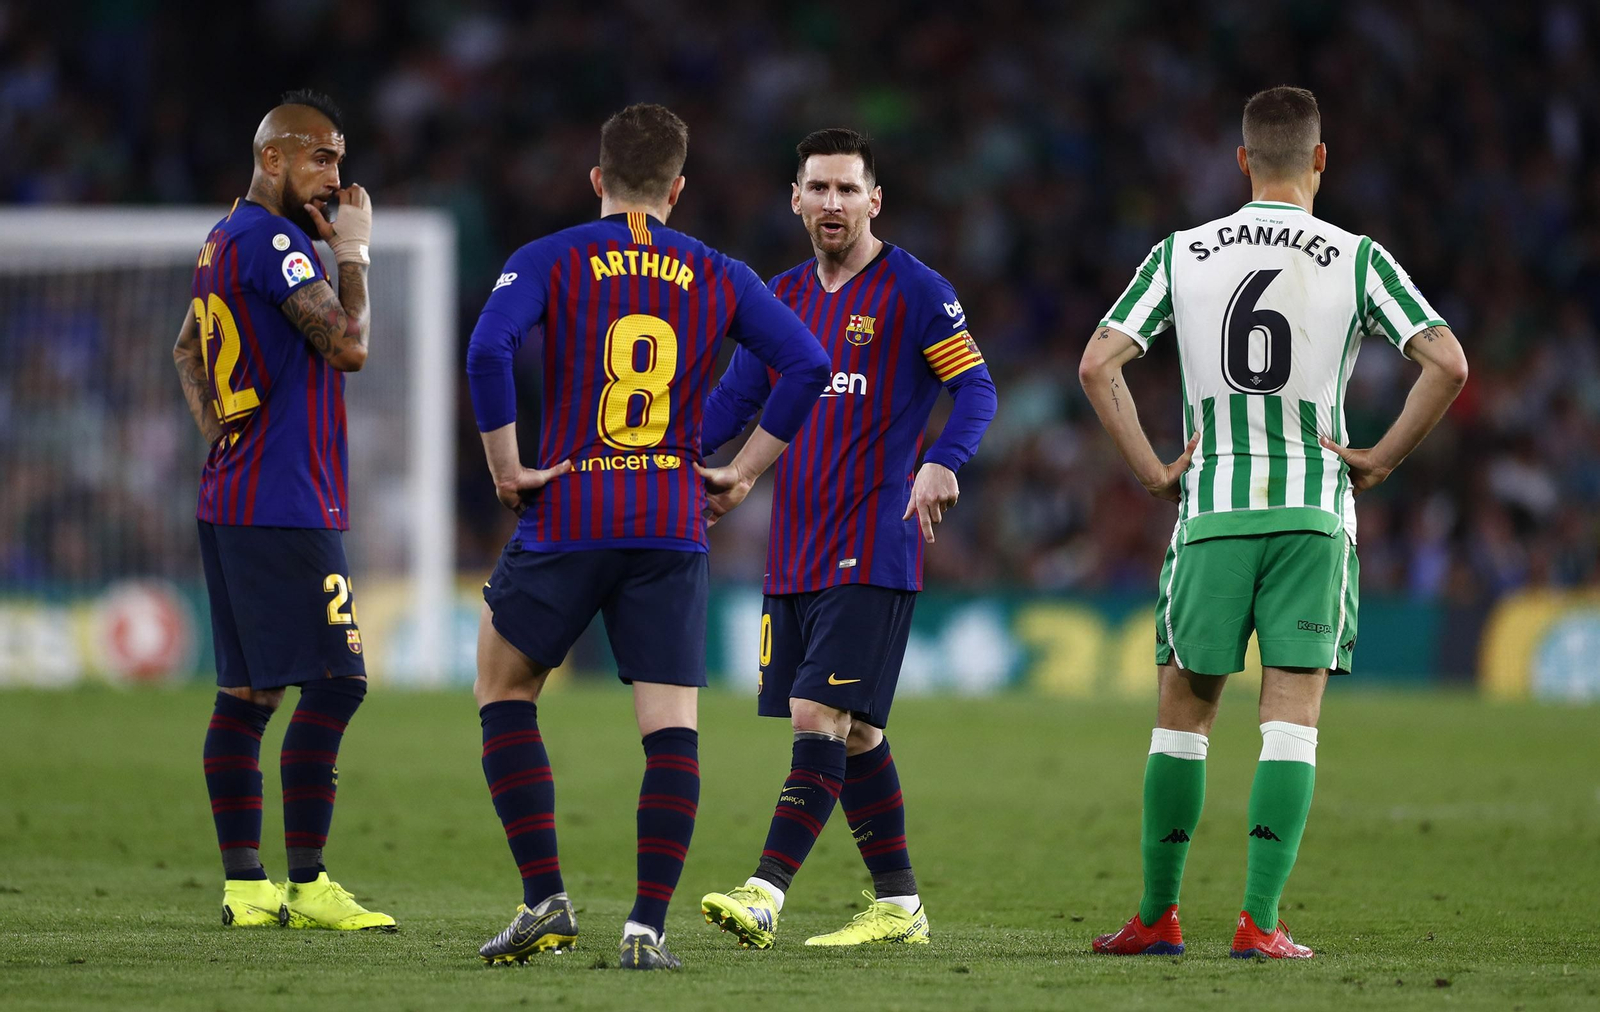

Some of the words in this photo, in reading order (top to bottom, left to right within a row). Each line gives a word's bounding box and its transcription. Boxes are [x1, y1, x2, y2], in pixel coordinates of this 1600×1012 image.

[1188, 225, 1340, 267] S.CANALES
[495, 272, 518, 286] ko
[589, 250, 695, 291] ARTHUR
[942, 297, 964, 318] be
[1220, 268, 1292, 395] 6
[597, 313, 678, 450] 8
[760, 613, 772, 667] 0
